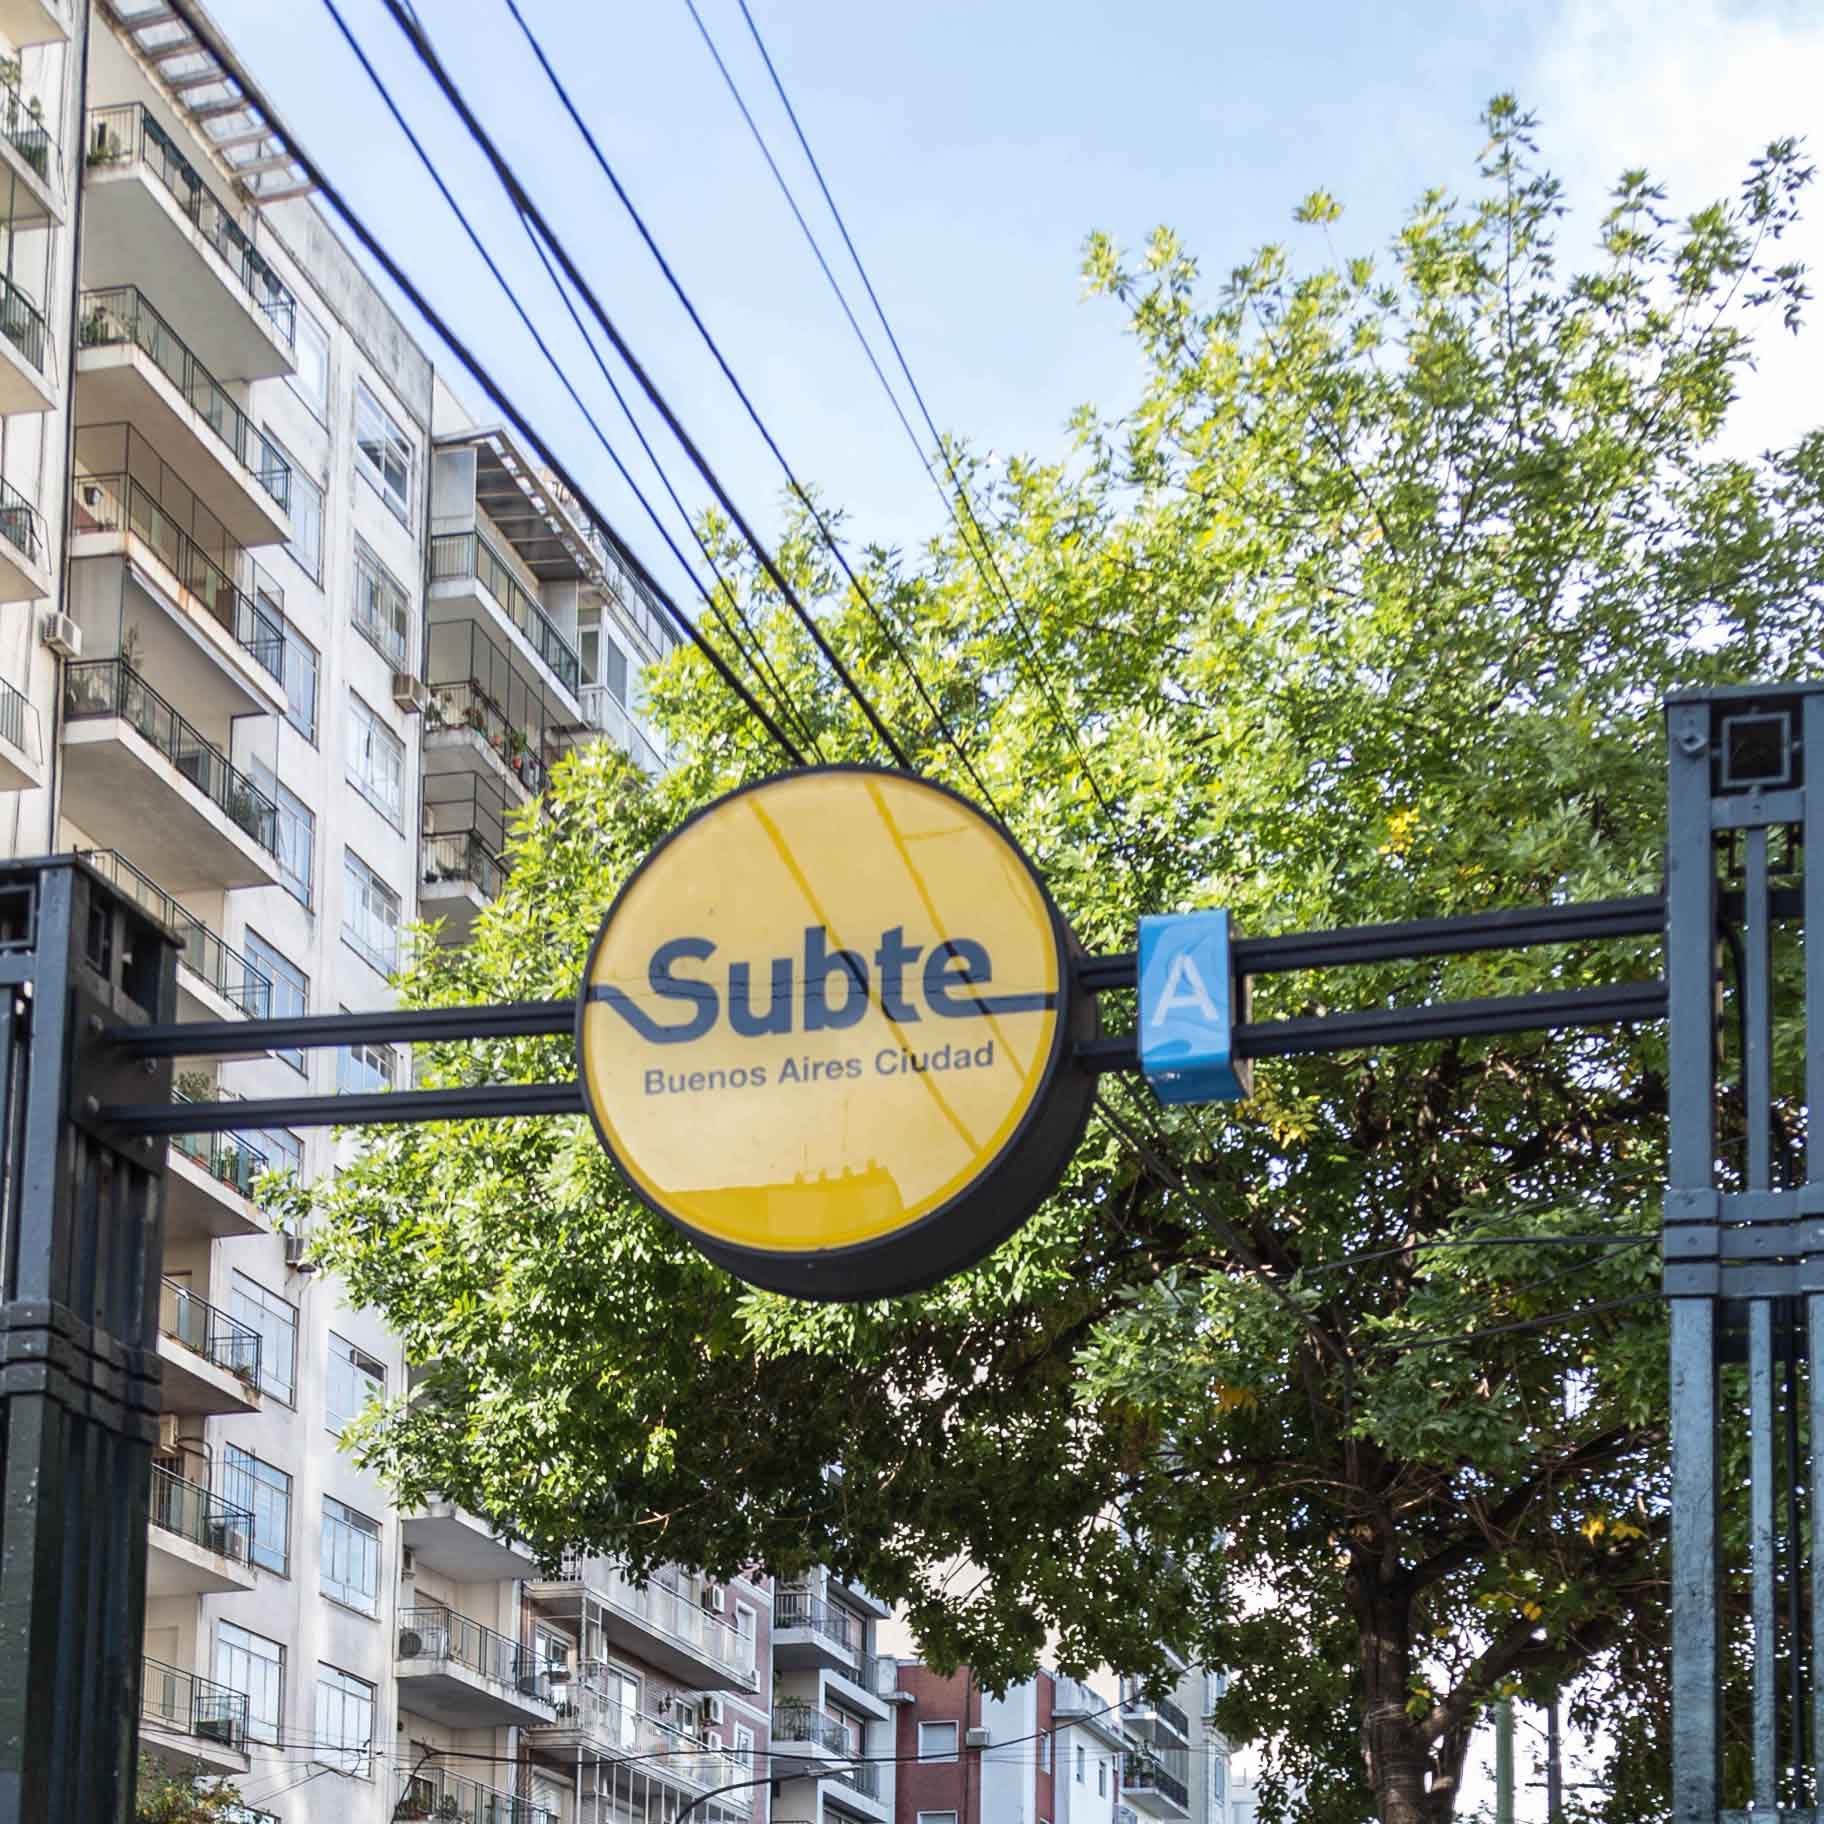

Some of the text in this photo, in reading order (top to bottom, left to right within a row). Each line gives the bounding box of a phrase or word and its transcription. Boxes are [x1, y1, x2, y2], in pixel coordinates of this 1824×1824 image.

[646, 925, 994, 1045] Subte
[1151, 953, 1219, 1026] A
[644, 1040, 994, 1095] Buenos Aires Ciudad
